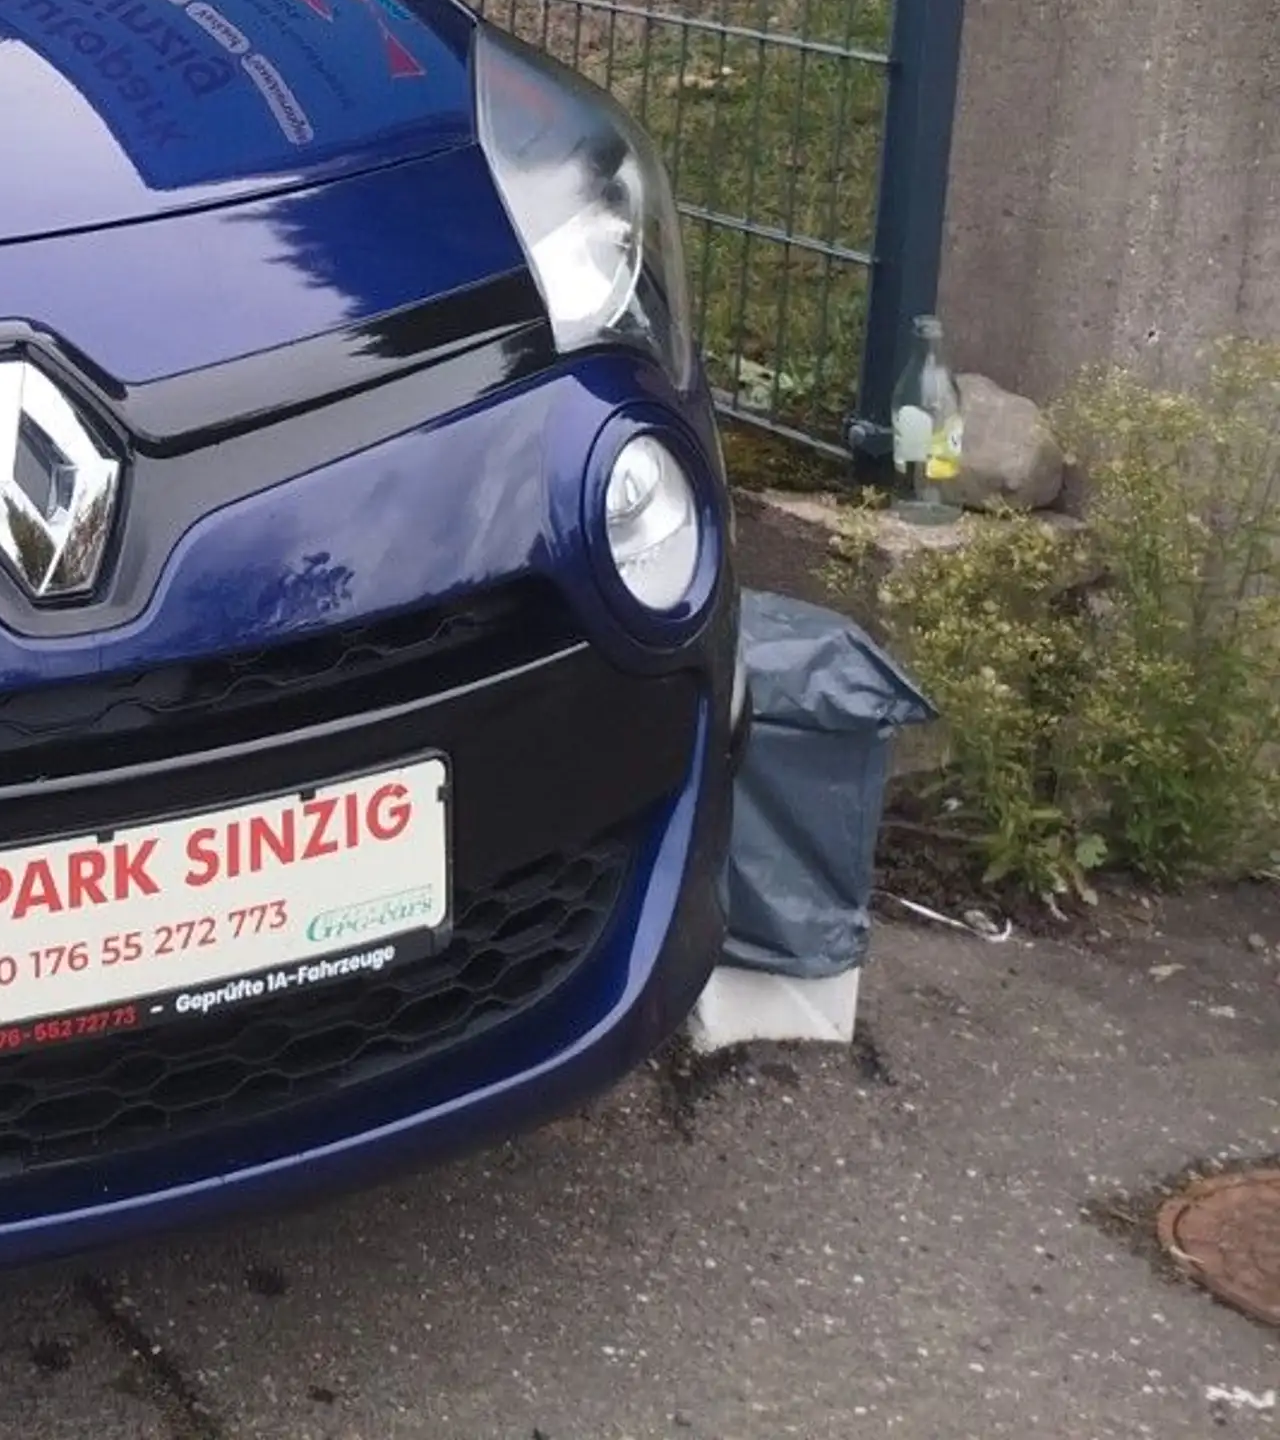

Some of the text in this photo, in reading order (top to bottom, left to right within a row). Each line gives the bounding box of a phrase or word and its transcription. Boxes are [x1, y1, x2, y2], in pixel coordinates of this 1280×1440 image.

[183, 781, 415, 889] SINZIG
[31, 940, 90, 981] 176
[100, 930, 144, 967] 55
[153, 917, 217, 956] 272
[228, 899, 288, 939] 773
[175, 977, 264, 1016] Geprüfte
[266, 944, 396, 992] 1A-Fahrzeuge
